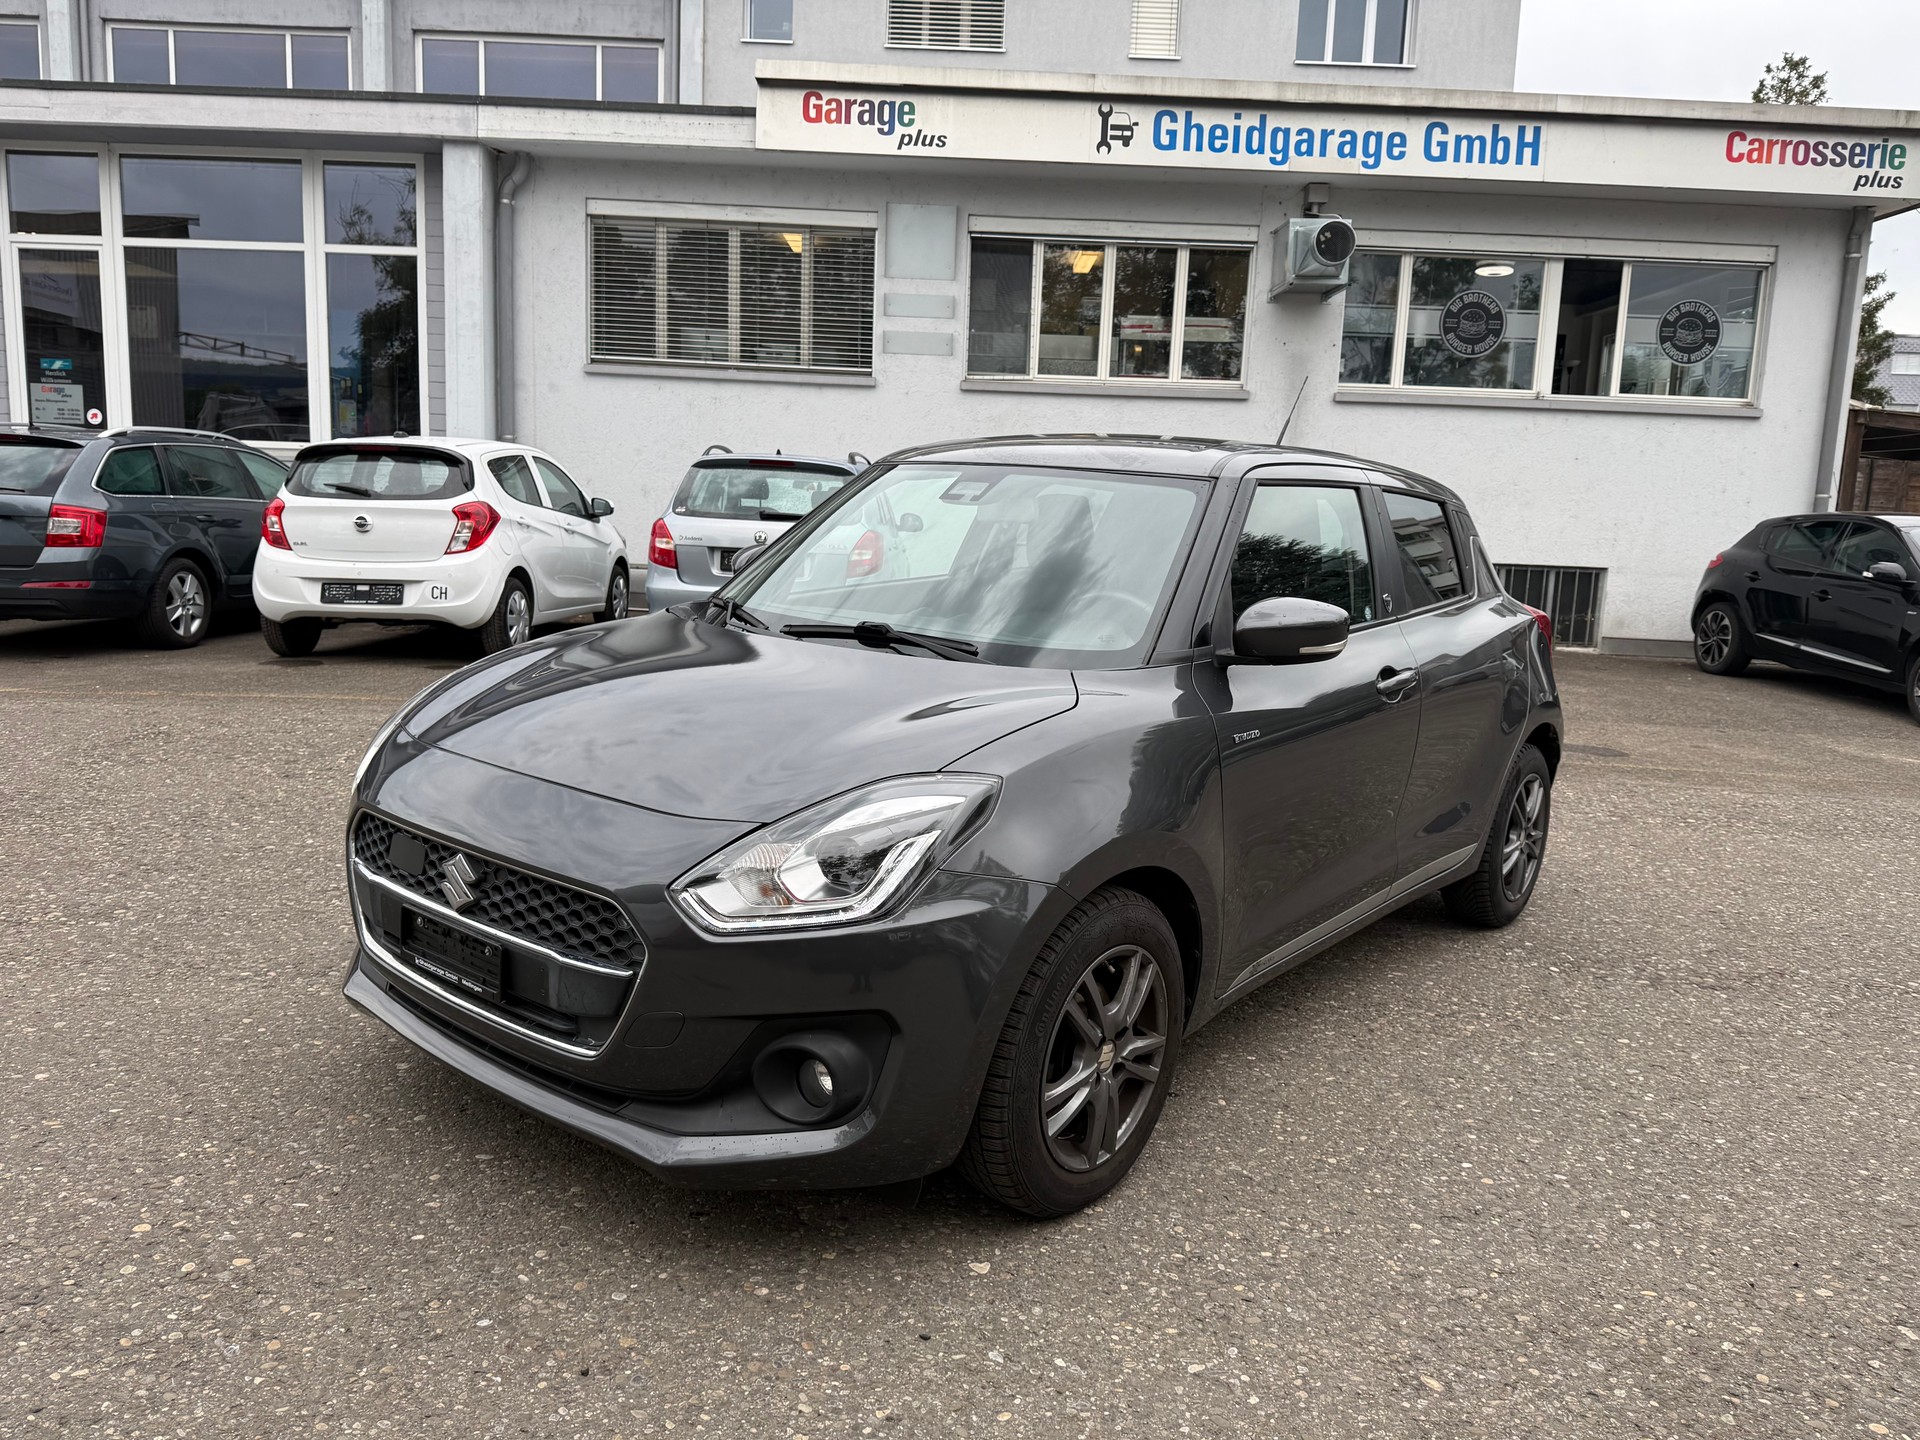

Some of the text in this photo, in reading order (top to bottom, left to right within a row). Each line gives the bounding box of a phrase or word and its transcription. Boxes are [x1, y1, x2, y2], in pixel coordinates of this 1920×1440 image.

[802, 90, 916, 136] Garage
[897, 129, 948, 150] plus
[1153, 110, 1542, 170] Gheidgarage GmbH
[1725, 130, 1907, 170] Carrosserie
[1853, 170, 1904, 192] plus
[1449, 293, 1500, 315] BIG BROTHERS
[1666, 302, 1717, 323] BIG BROTHERS
[1446, 332, 1498, 354] BURGER HOUSE
[1662, 341, 1714, 363] BURGER HOUSE
[41, 385, 65, 395] Garage
[431, 585, 448, 601] CH
